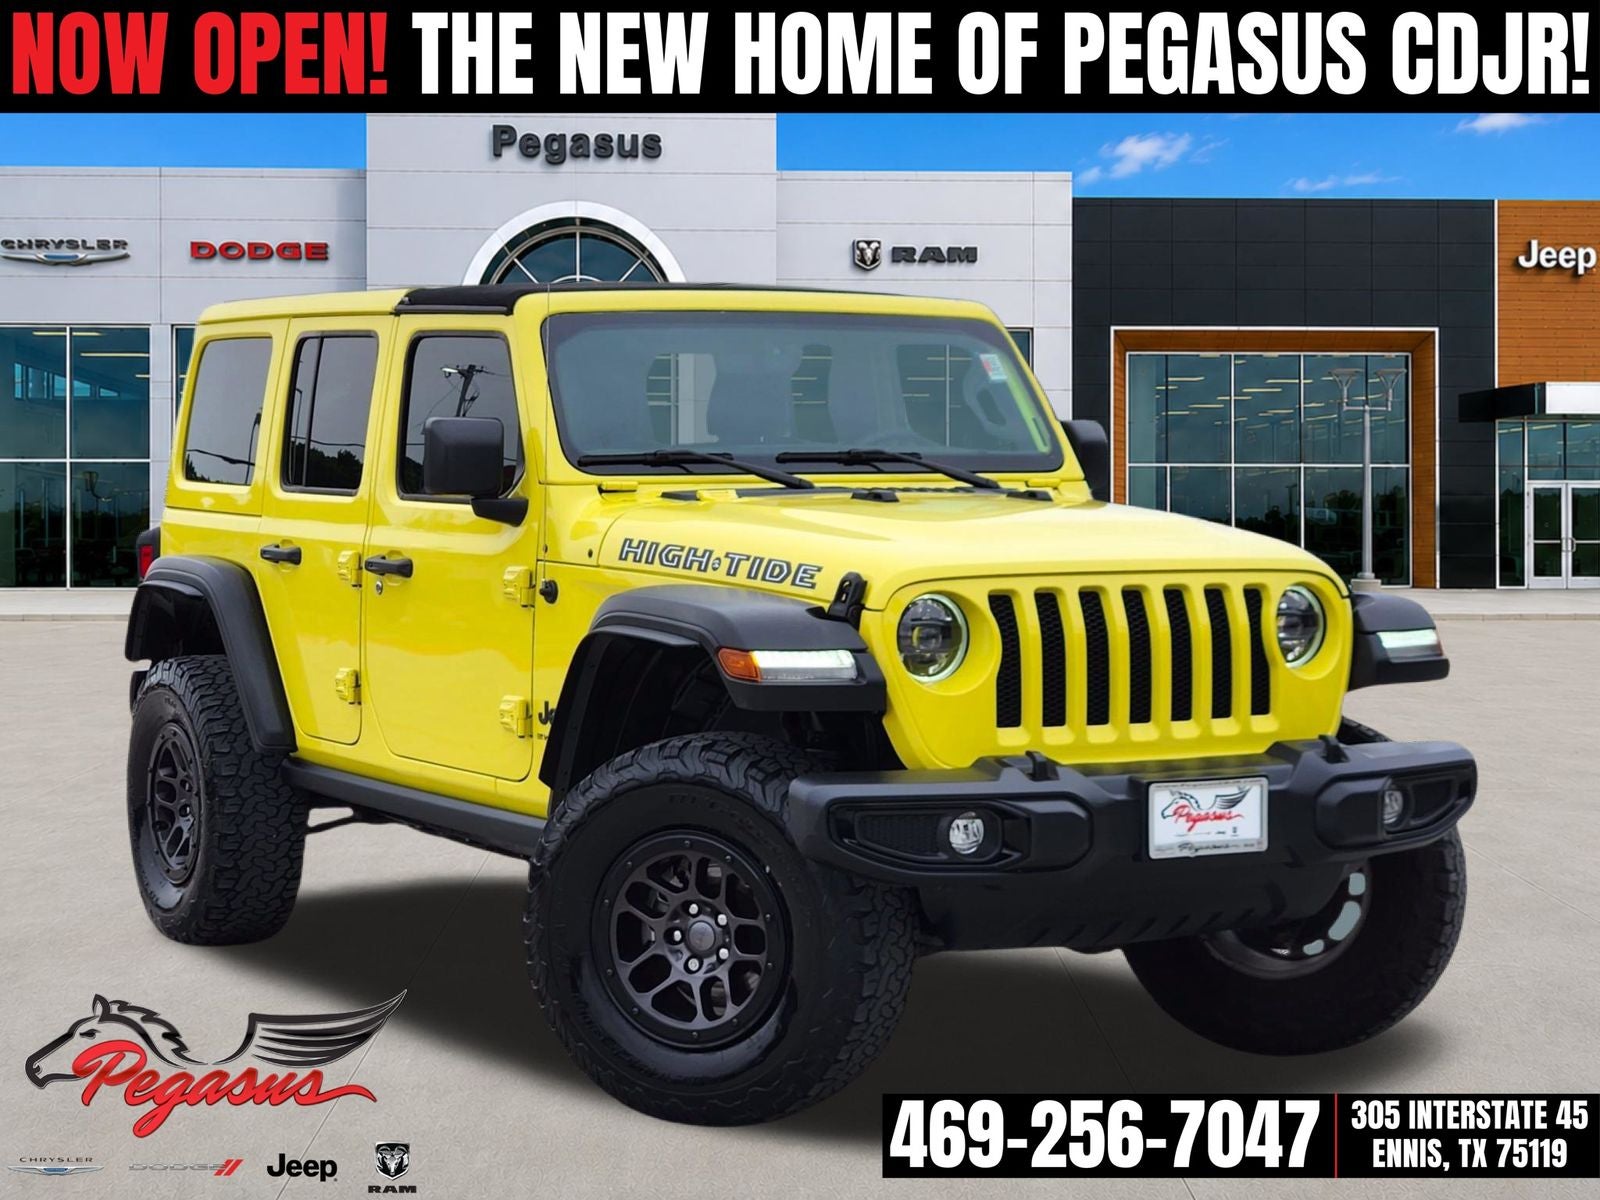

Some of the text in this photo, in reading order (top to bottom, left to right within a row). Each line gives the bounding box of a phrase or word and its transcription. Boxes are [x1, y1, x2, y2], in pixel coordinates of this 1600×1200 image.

[491, 124, 663, 166] Pegasus
[1, 238, 129, 250] CHRYSLER
[189, 240, 329, 261] DODGE
[891, 246, 978, 263] RAM
[1518, 239, 1597, 275] Jeep
[618, 537, 823, 590] HIGH TIDE
